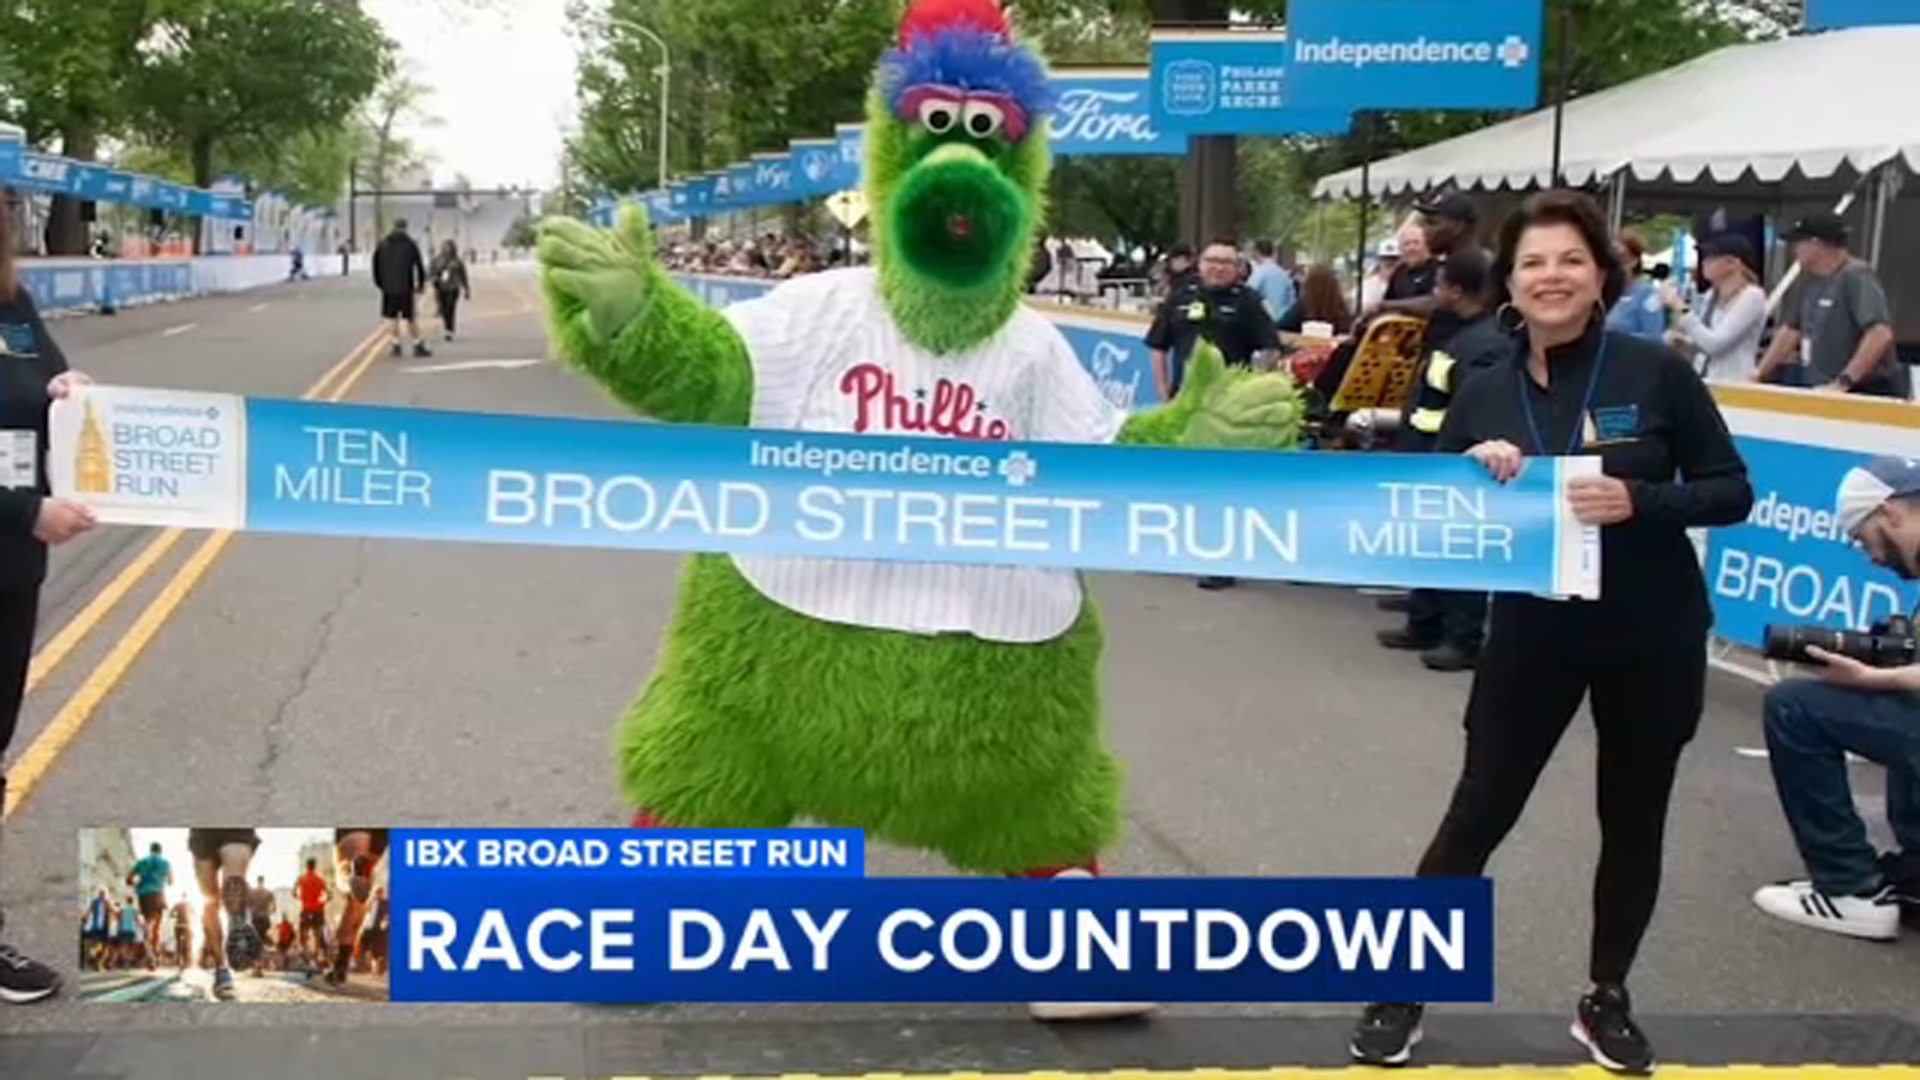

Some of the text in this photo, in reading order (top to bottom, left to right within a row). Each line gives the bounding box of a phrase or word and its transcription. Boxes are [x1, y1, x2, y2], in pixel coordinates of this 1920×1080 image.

[1295, 37, 1491, 68] Independence
[840, 363, 1014, 439] Phillie
[113, 423, 221, 449] BROAD
[303, 426, 408, 467] TEN
[114, 449, 216, 475] STREET
[750, 440, 991, 477] Independence
[115, 474, 179, 497] RUN
[275, 464, 431, 506] MILER
[1377, 482, 1487, 520] TEN
[487, 469, 1298, 563] BROAD STREET RUN
[1349, 520, 1513, 562] MILER
[1715, 547, 1899, 632] BROAD
